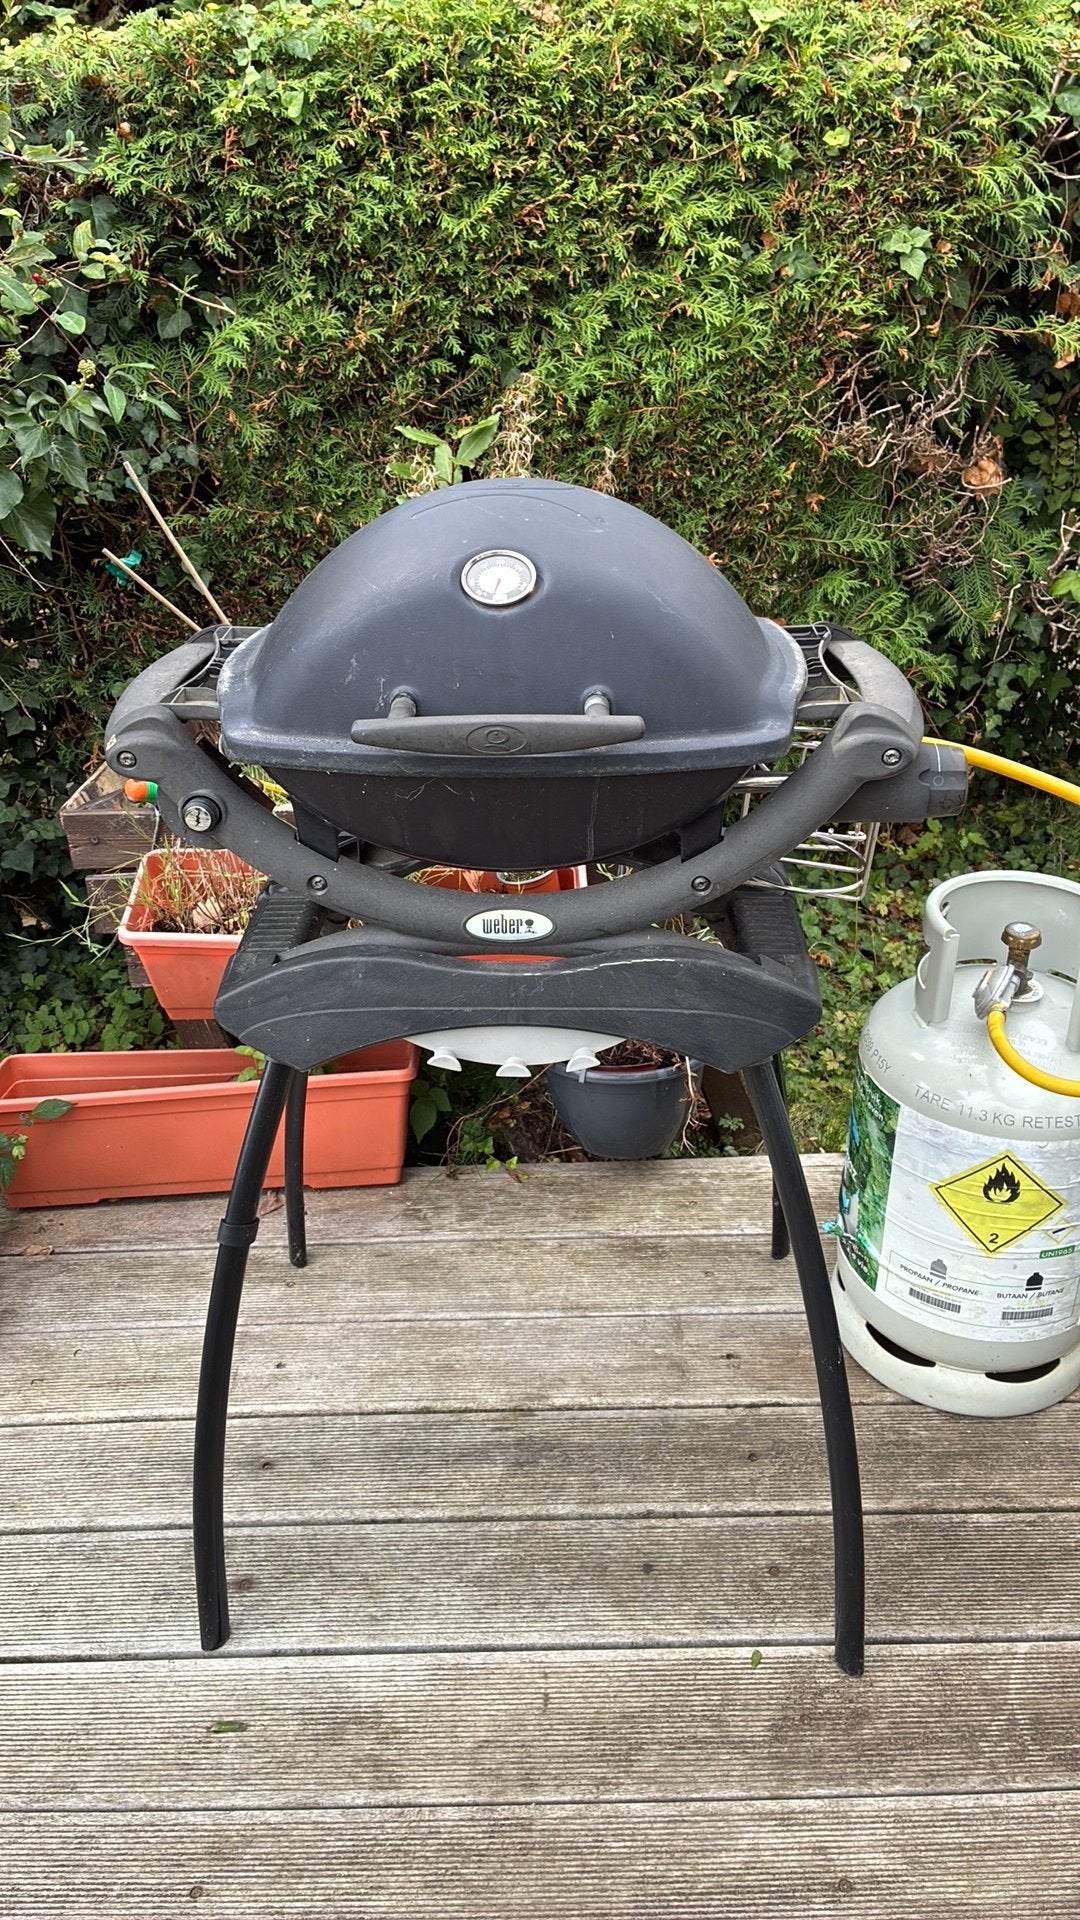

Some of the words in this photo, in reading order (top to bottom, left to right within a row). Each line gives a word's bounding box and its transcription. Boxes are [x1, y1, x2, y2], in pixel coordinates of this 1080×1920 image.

[482, 914, 523, 935] weber
[871, 1049, 892, 1073] P15Y
[913, 1084, 952, 1111] TARE
[959, 1101, 988, 1122] 11.3
[992, 1112, 1015, 1127] KG
[1022, 1114, 1080, 1129] RETEST
[989, 1233, 999, 1244] 2
[1041, 1247, 1073, 1258] UN1965
[900, 1264, 933, 1283] PROPAAN
[942, 1282, 980, 1296] PROPANE
[1037, 1287, 1064, 1298] BUTANE
